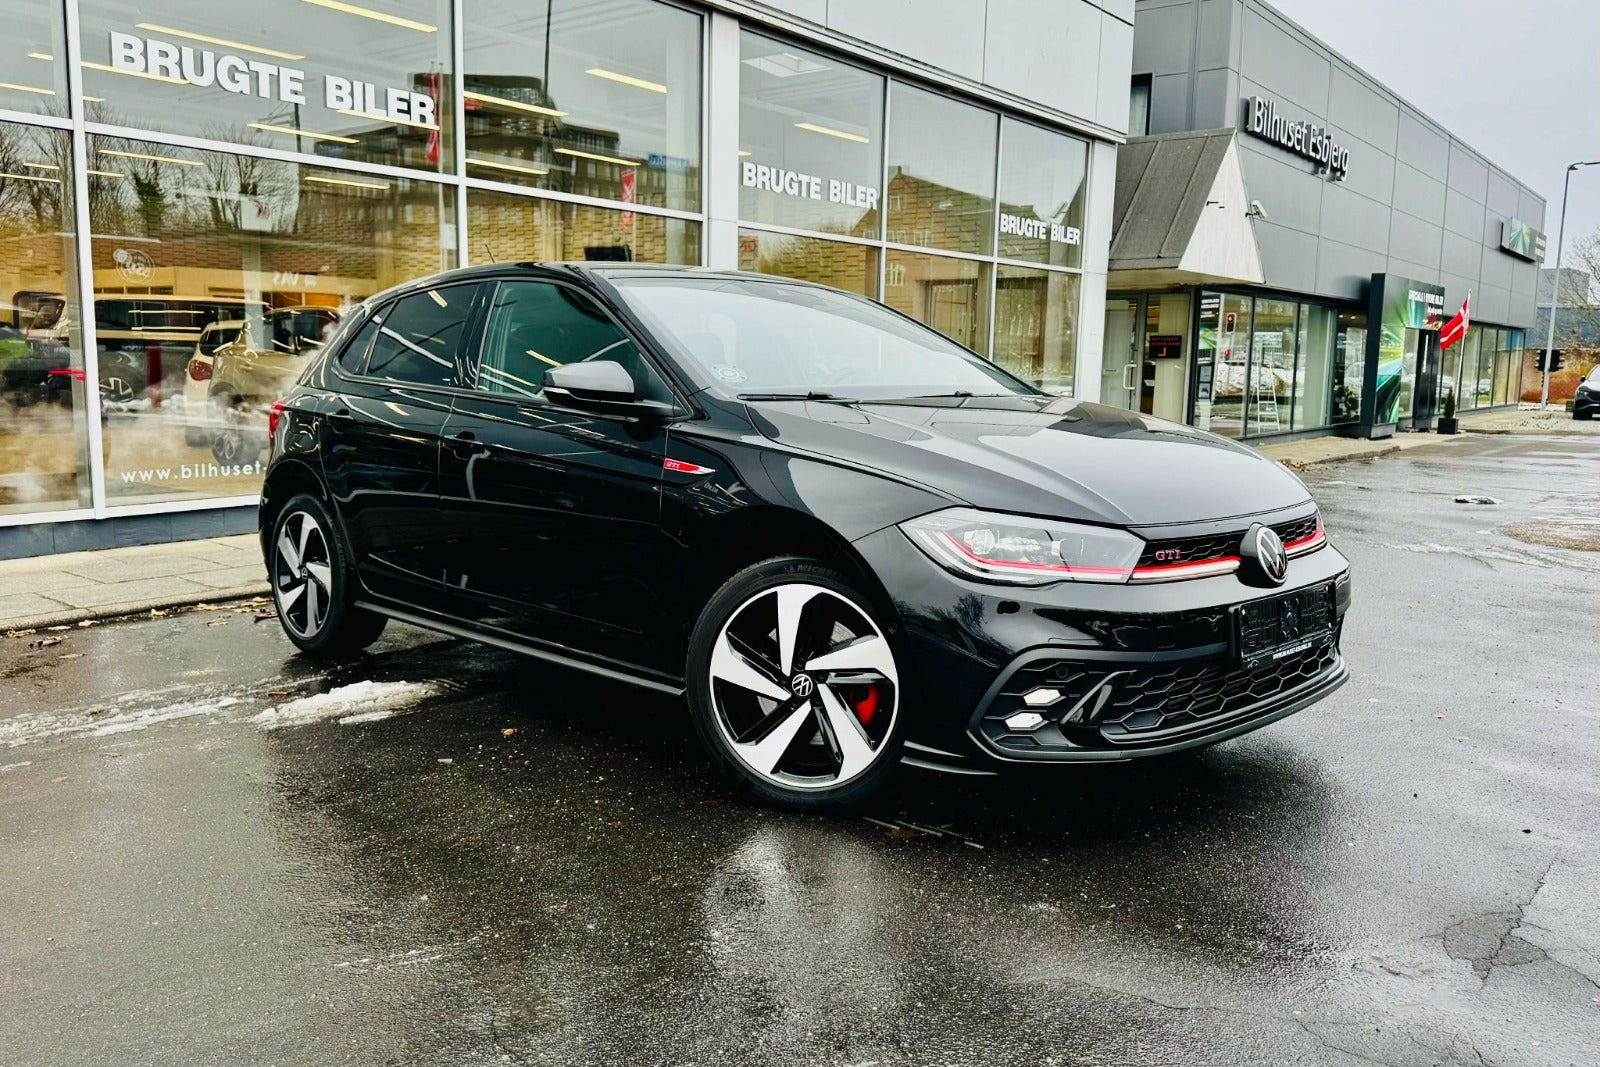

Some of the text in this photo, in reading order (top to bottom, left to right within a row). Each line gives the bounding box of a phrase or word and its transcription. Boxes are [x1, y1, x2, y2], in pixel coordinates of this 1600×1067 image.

[110, 31, 436, 126] BRUGTE BILER
[1252, 95, 1349, 182] Bilhuset Esbjerg
[742, 161, 879, 210] BRUGTE BILER
[1000, 212, 1081, 246] BRUGTE BILER
[666, 461, 680, 469] GTI
[1155, 548, 1181, 561] GTI
